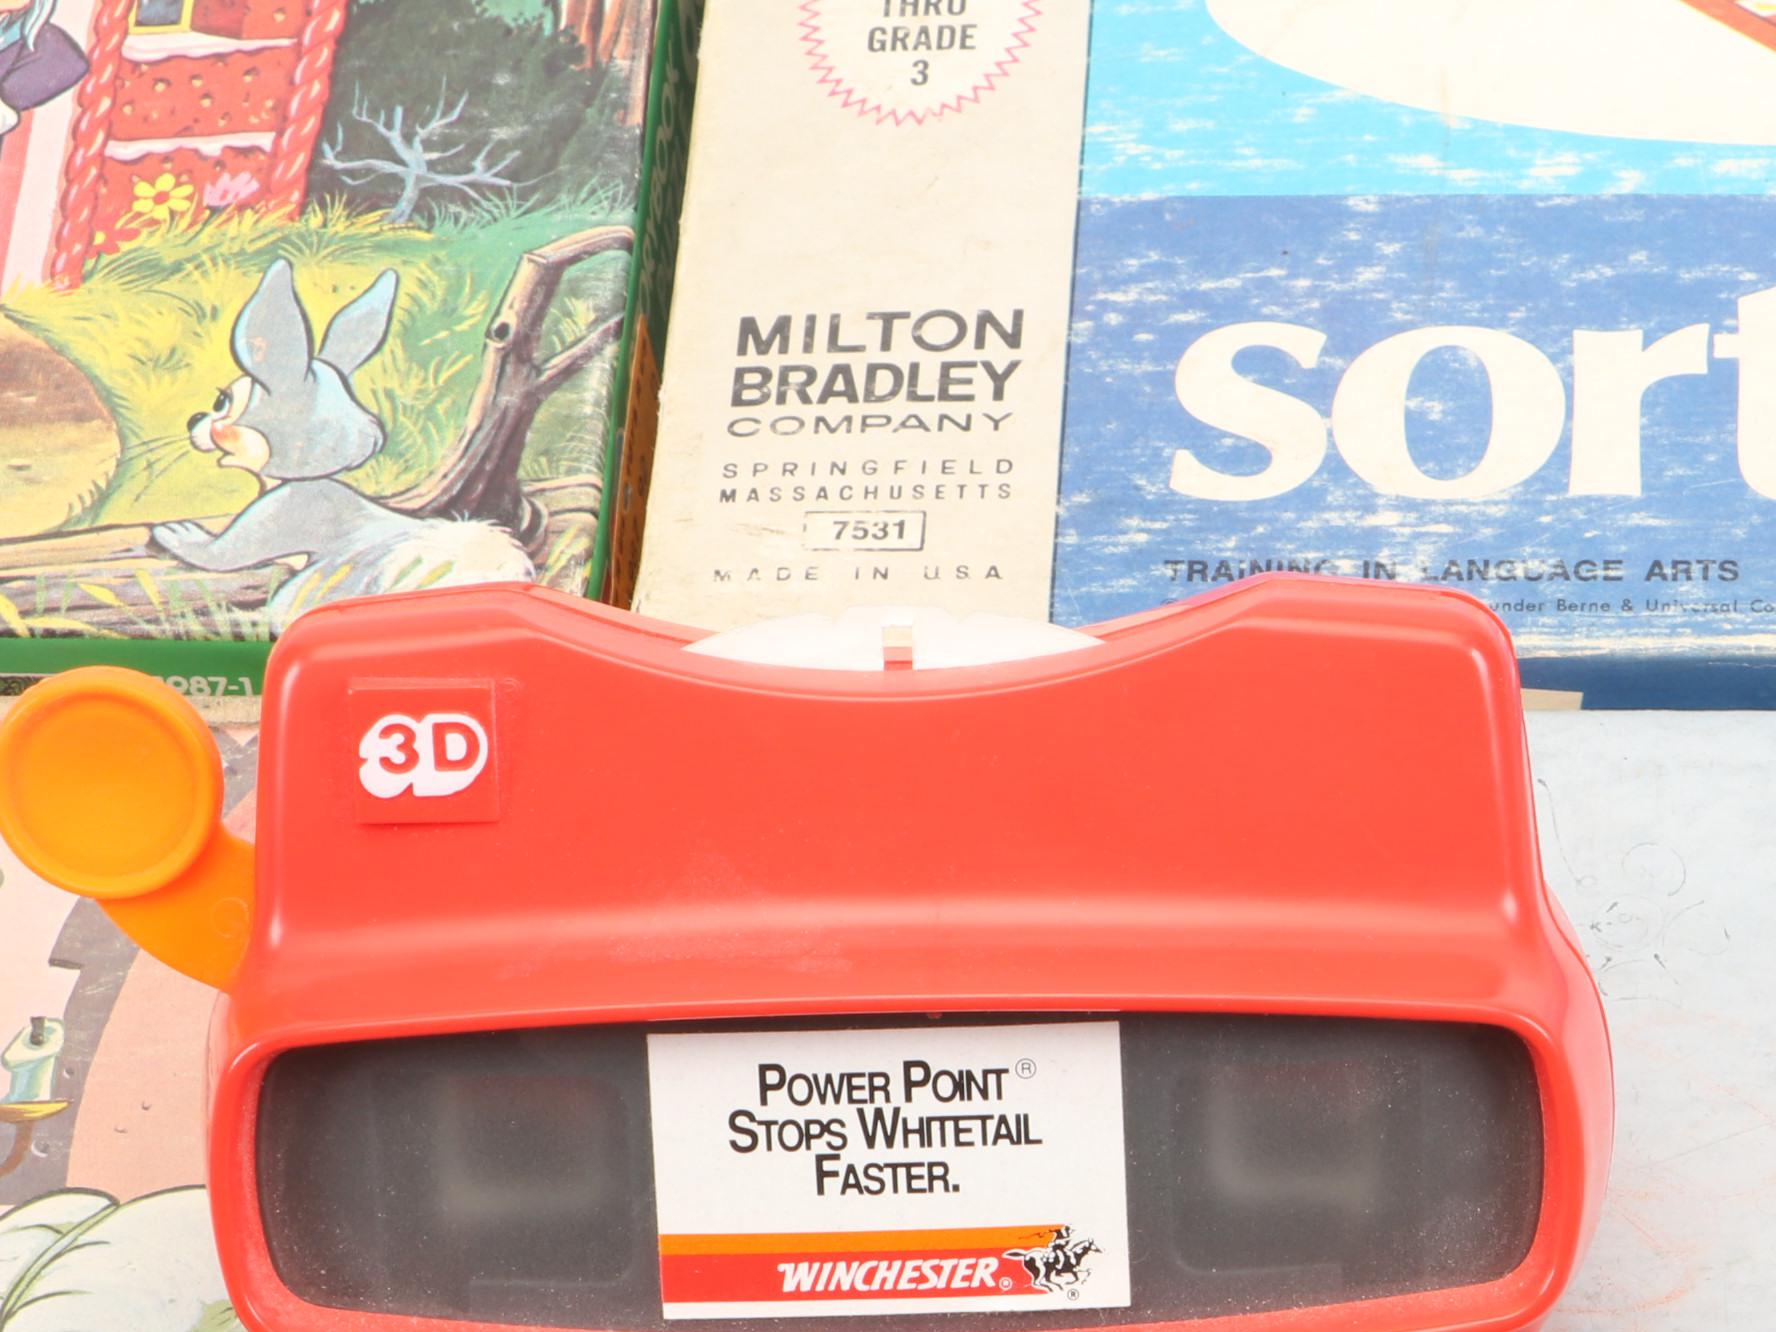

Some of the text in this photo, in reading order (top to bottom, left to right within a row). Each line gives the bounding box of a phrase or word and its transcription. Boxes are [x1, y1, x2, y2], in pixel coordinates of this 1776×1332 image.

[867, 24, 978, 52] GRADE
[910, 59, 930, 86] 3
[736, 308, 1025, 357] MILTON
[730, 360, 1023, 408] BRADLEY
[727, 412, 1015, 438] COMPANY
[722, 459, 1014, 479] SPRINGFIELD
[719, 483, 1012, 504] MASSACHUSETTS
[832, 519, 907, 541] 7531
[713, 566, 820, 582] MADE
[854, 566, 890, 581] IN
[1362, 560, 1398, 581] IN
[1422, 559, 1624, 582] LANGUAGE
[1645, 559, 1740, 582] ARTS
[1557, 598, 1613, 613] Berne
[1621, 599, 1635, 613] &
[152, 675, 255, 697] 987-1
[368, 716, 486, 785] 3D
